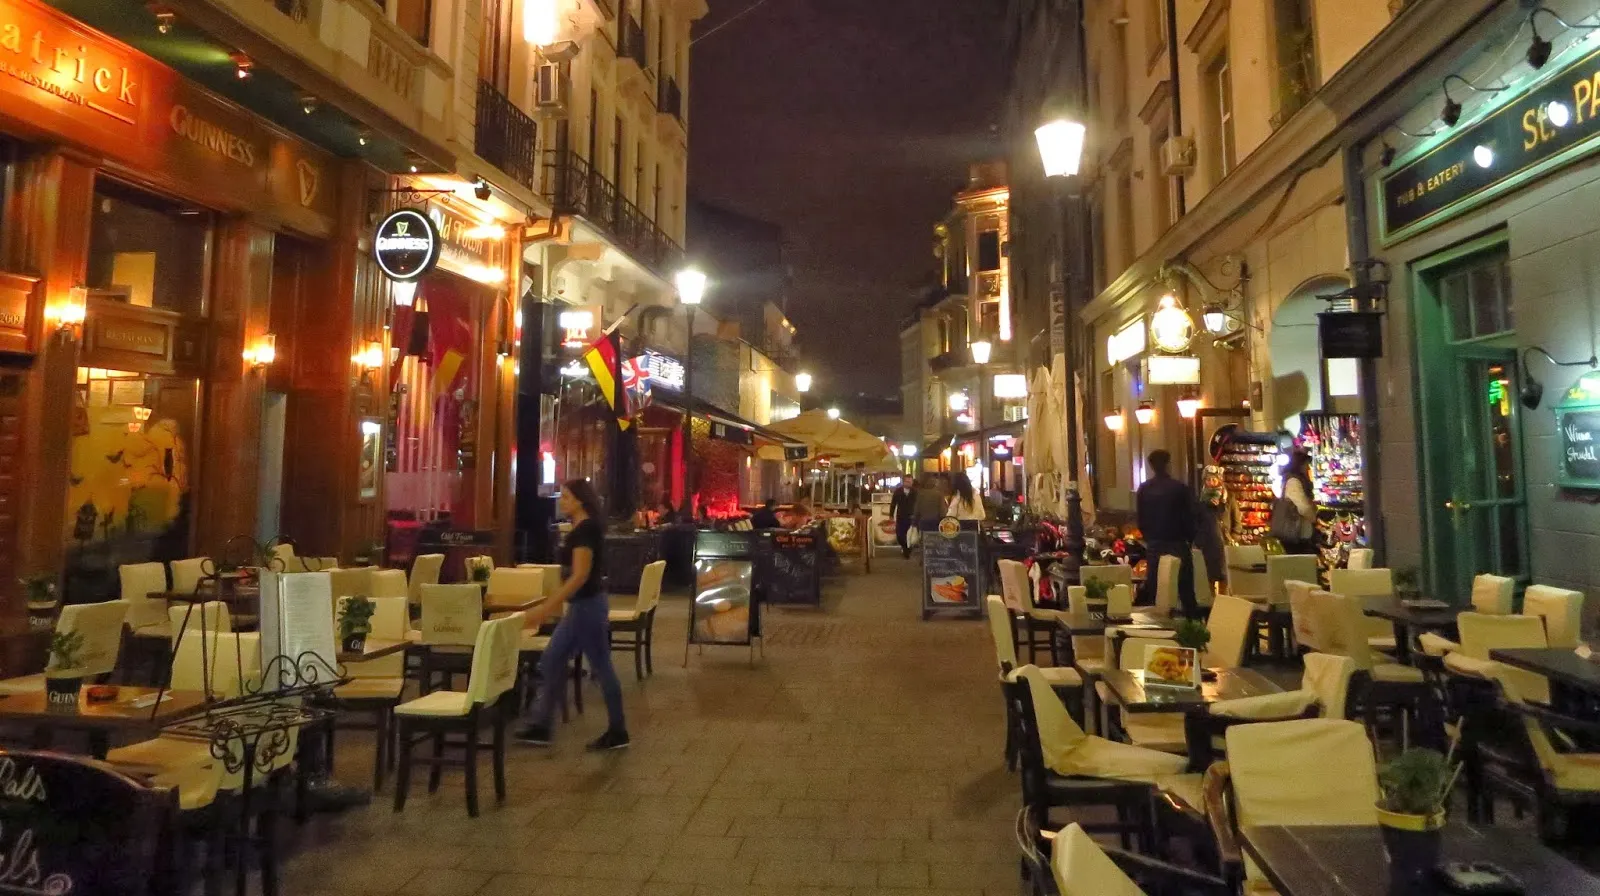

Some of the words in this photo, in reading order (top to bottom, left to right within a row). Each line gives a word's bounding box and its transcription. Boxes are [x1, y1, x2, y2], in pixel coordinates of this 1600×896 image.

[169, 105, 254, 167] GUINNESS
[1522, 101, 1556, 152] St.
[1417, 182, 1424, 197] &
[1427, 160, 1464, 191] EATERY
